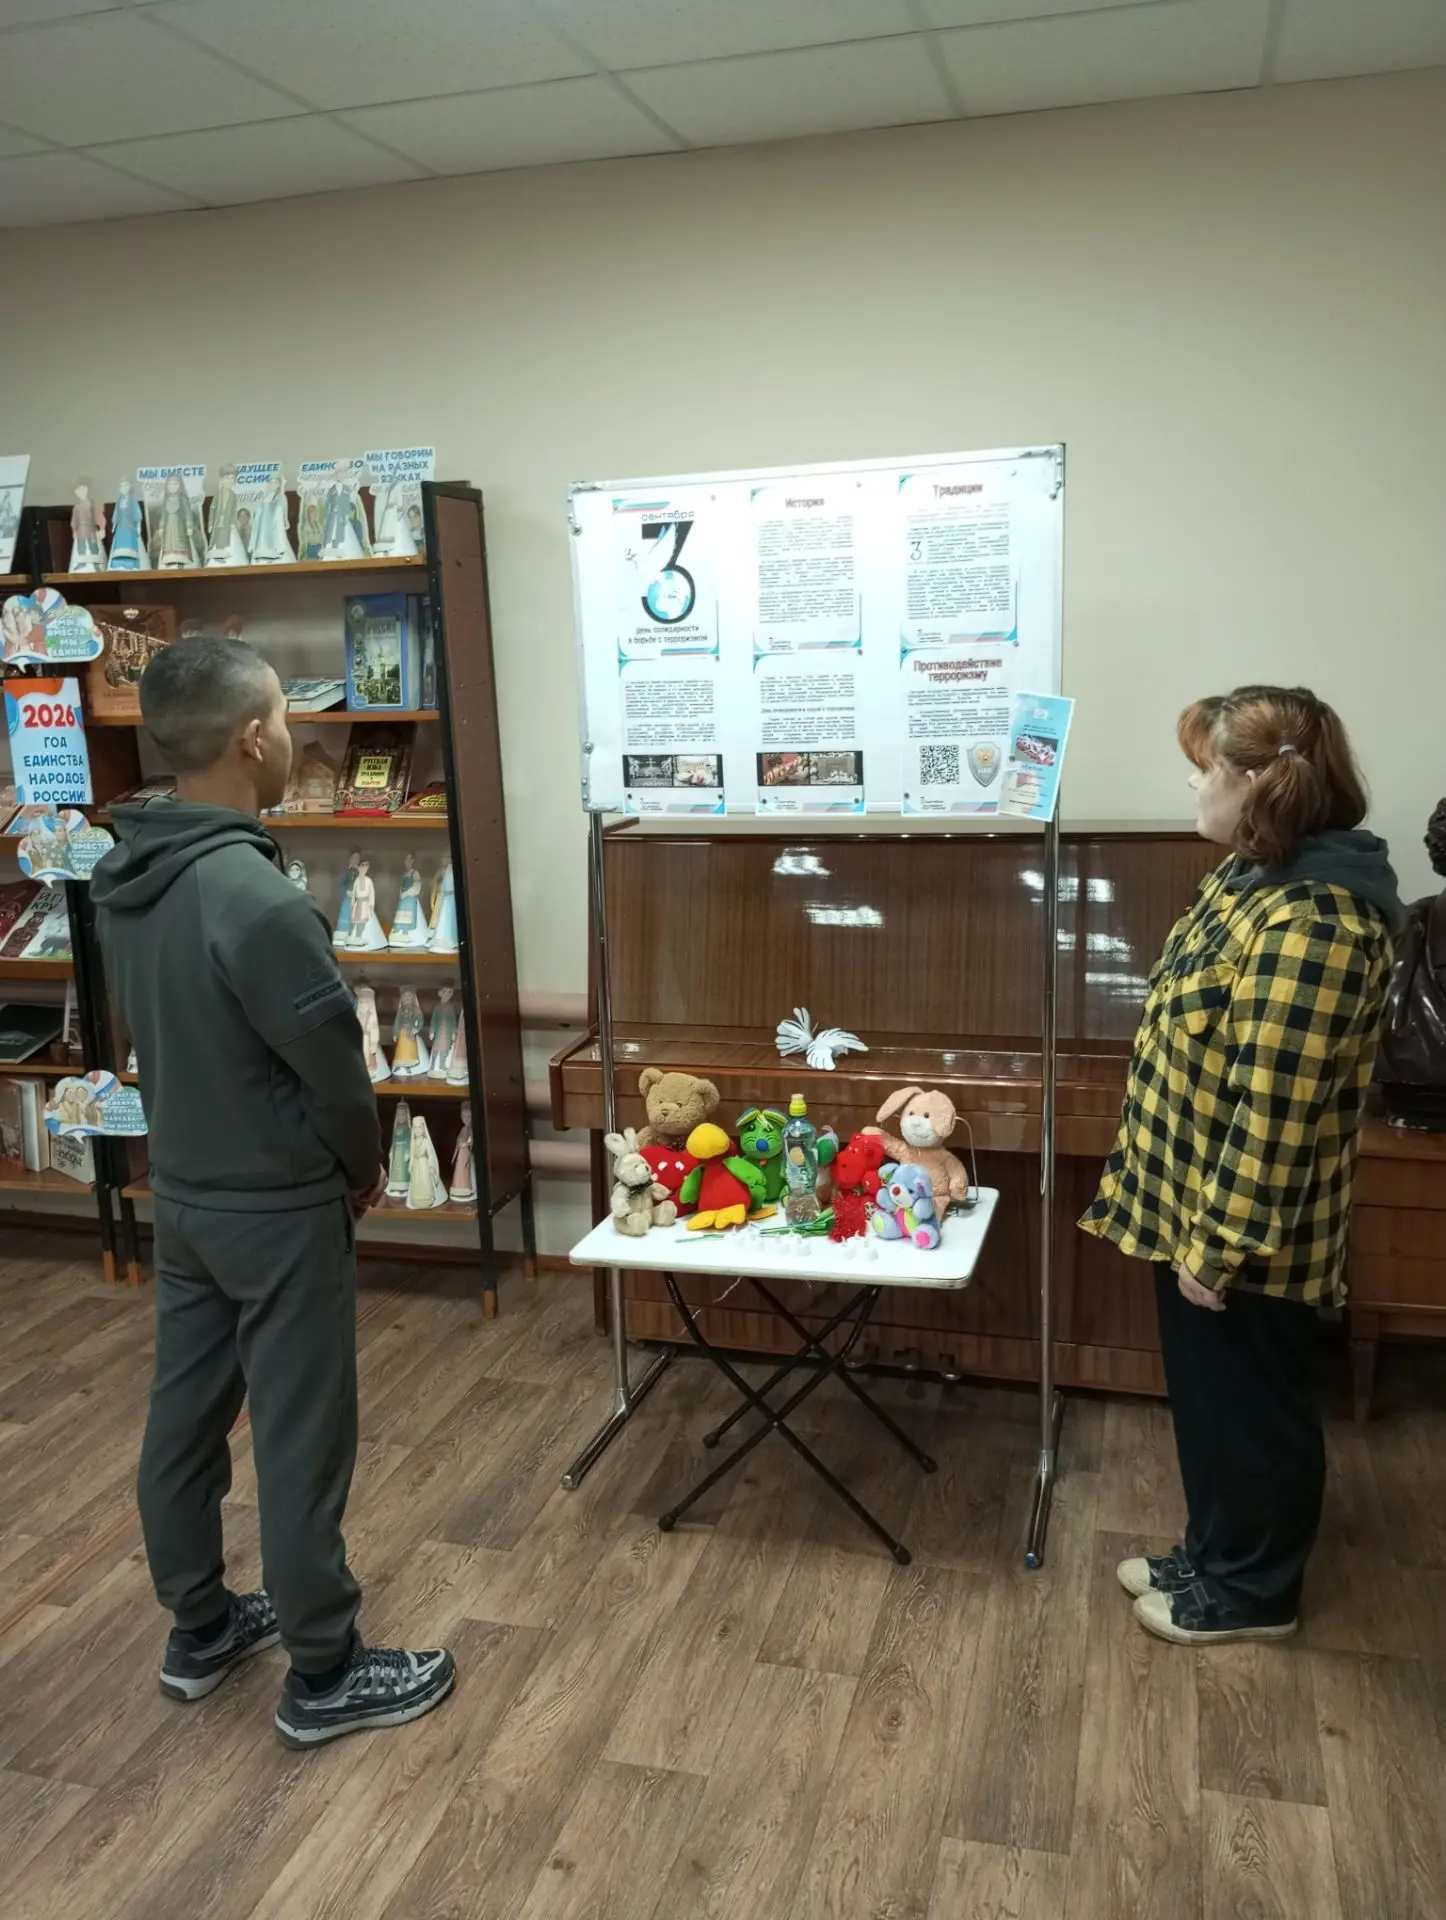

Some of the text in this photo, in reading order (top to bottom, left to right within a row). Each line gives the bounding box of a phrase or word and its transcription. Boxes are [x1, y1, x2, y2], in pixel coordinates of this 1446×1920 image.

[366, 449, 433, 462] МЫ ГОВОРИМ
[139, 466, 205, 479] МЫ ВМЕСТЕ
[301, 460, 364, 472] ЕДИНСВО
[371, 461, 429, 473] НА РАЗНЫХ
[237, 474, 271, 484] ССИИ
[932, 483, 983, 498] Традиции
[785, 498, 825, 509] История
[642, 510, 695, 521] сентября
[641, 520, 696, 624] 3
[913, 657, 1003, 672] Противодействие
[928, 670, 988, 684] терроризму
[22, 703, 76, 728] 2026
[44, 736, 68, 749] ГОД
[23, 754, 84, 767] ЕДИНСТВА
[28, 772, 85, 785] НАРОДОВ
[32, 790, 87, 803] РОССИИ!
